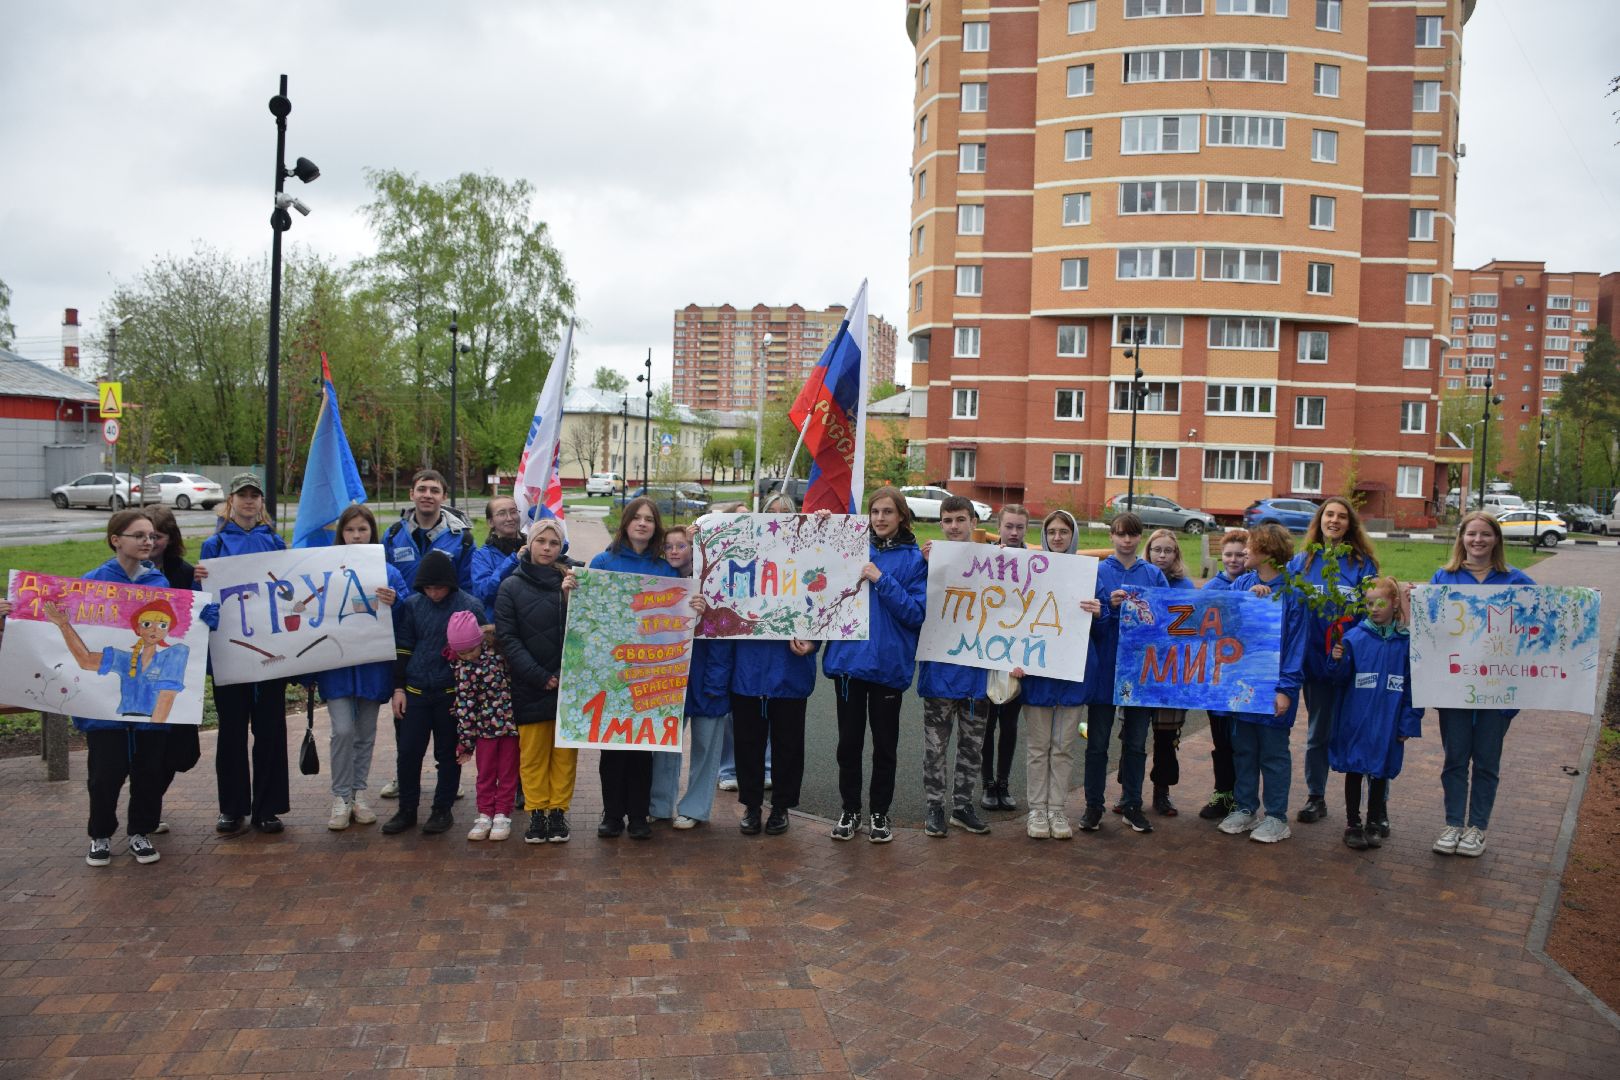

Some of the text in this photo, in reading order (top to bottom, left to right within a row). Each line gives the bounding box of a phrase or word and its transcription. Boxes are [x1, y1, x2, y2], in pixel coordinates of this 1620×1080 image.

[106, 425, 117, 436] 40
[728, 559, 797, 598] МАЙ
[219, 568, 378, 637] ТРУД
[643, 592, 674, 606] МИР
[76, 601, 119, 624] МАЯ
[641, 617, 684, 632] ТРУД
[615, 645, 684, 660] СВОБОДА
[1140, 637, 1244, 686] МИР
[633, 677, 687, 697] БРАТСТВО
[582, 690, 679, 747] 1 МАЯ
